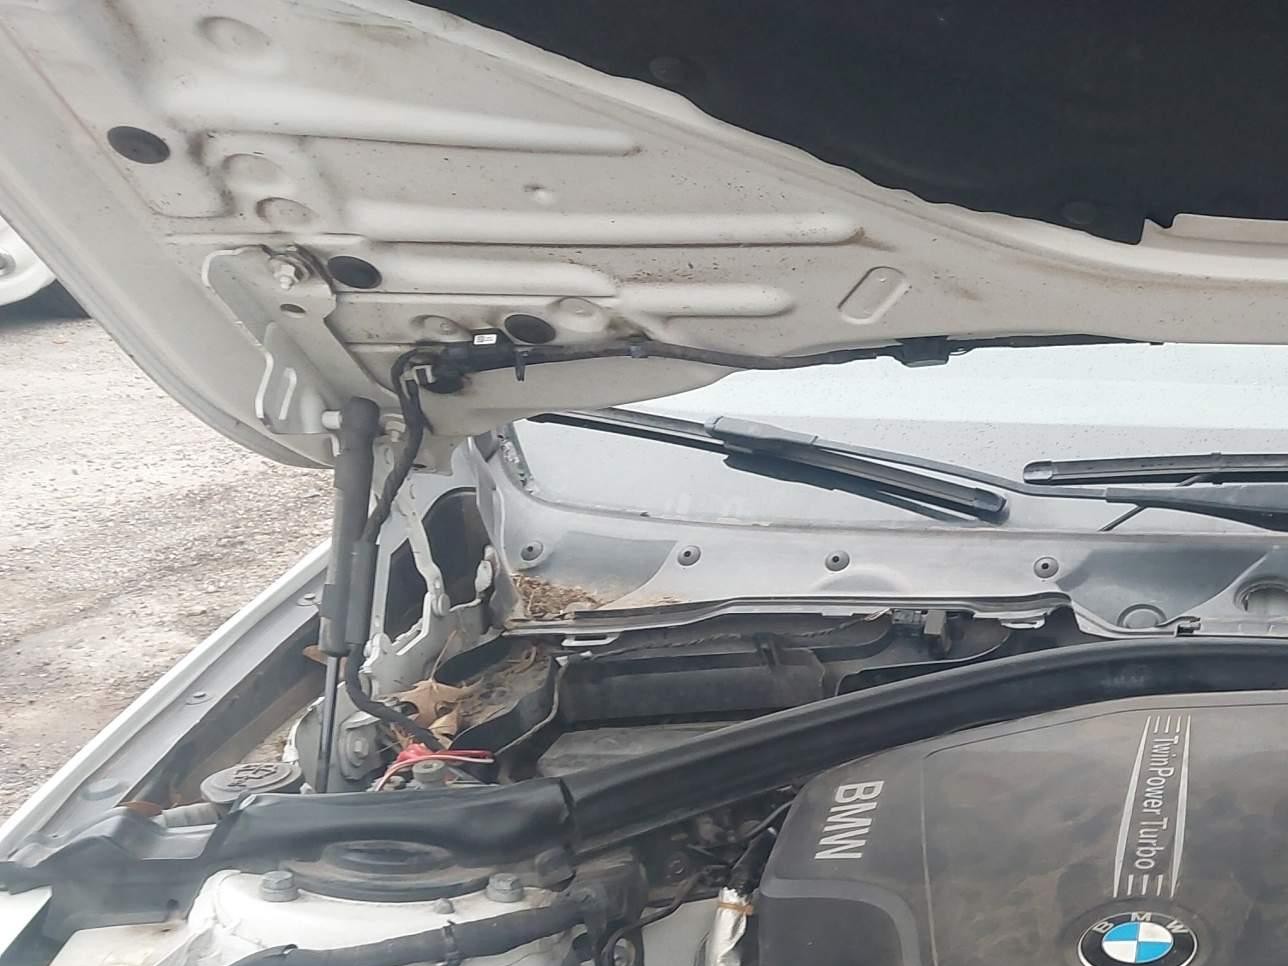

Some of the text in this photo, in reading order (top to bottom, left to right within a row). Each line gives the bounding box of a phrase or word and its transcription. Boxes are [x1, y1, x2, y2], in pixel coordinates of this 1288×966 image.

[814, 780, 885, 860] BMW
[1134, 735, 1179, 870] TwinPower Turbo
[1092, 911, 1190, 934] BMW
